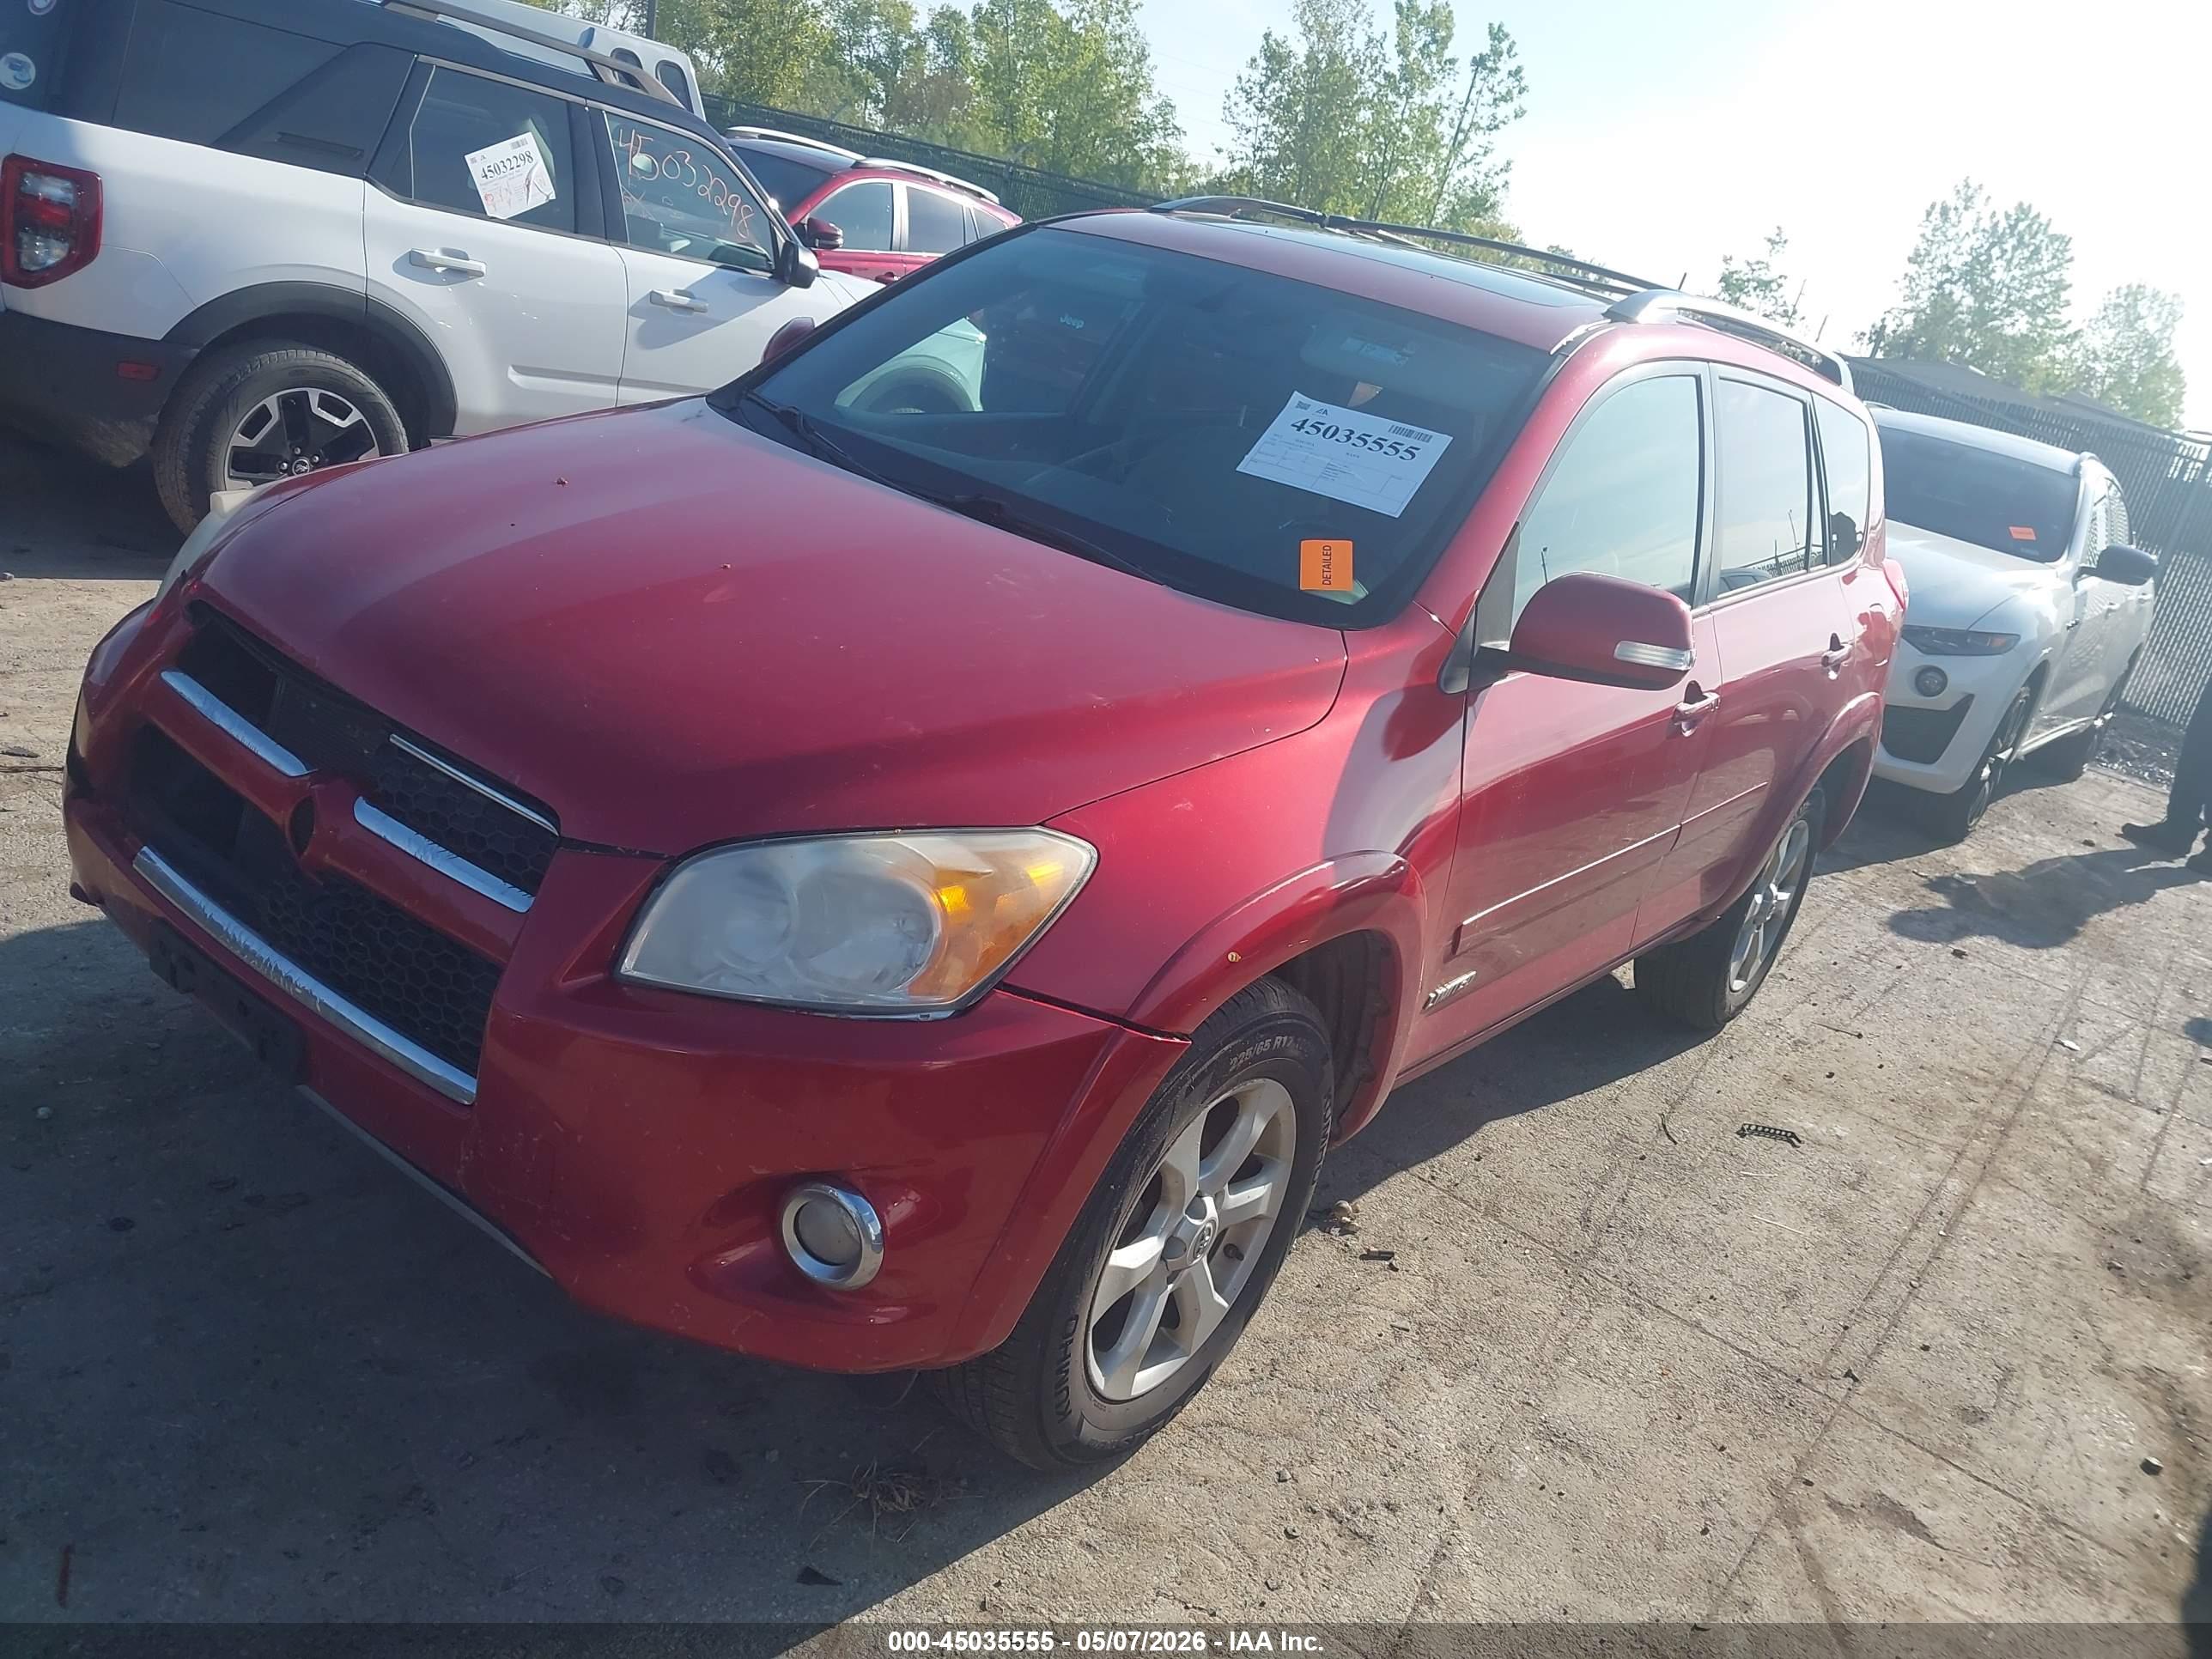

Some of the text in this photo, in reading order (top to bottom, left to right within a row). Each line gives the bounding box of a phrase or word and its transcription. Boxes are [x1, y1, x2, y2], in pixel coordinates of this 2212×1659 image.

[481, 150, 534, 179] 45032298
[619, 128, 755, 239] 45032298
[1291, 417, 1421, 461] 45035555
[1322, 544, 1332, 586] DETAILED
[1054, 1314, 1079, 1424] KUMHO
